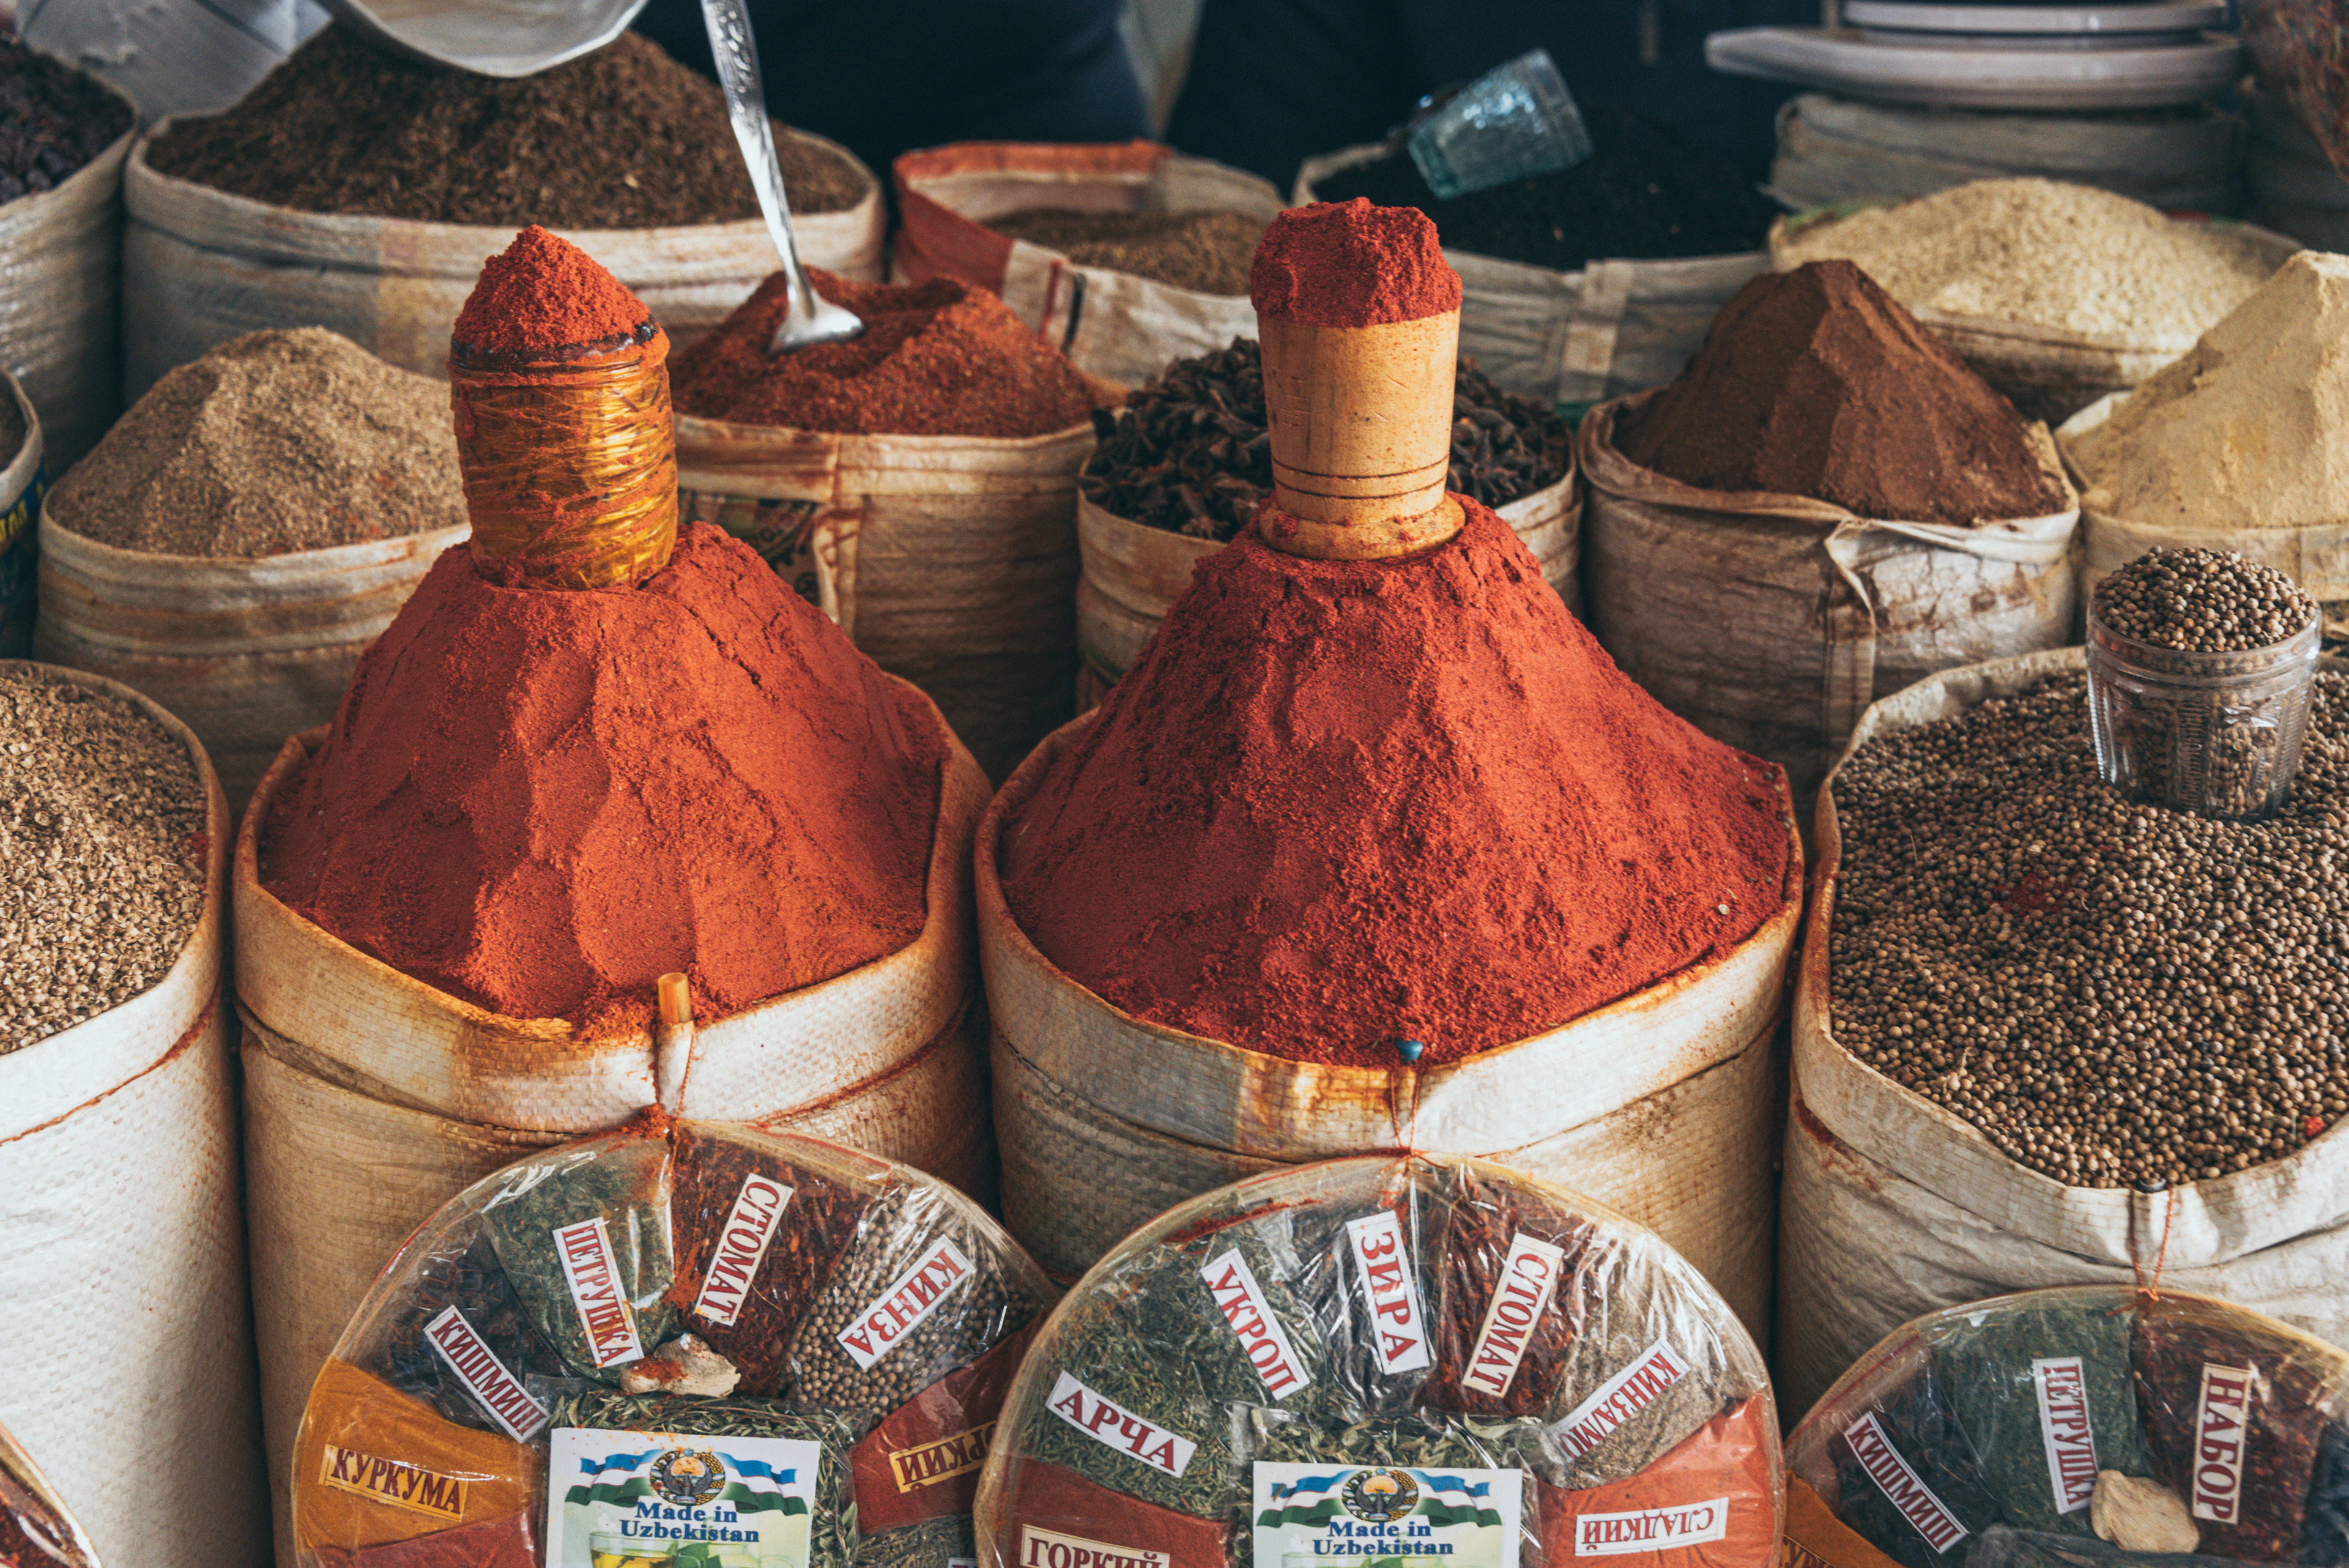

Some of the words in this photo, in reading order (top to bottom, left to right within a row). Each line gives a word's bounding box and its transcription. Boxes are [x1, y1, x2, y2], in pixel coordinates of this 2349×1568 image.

[562, 1224, 634, 1363] ПЕТРУШКА
[700, 1182, 780, 1321] С/ТОМАТ
[843, 1248, 965, 1356] КИНЗА
[1361, 1231, 1417, 1363] ЗИРА
[432, 1314, 547, 1435] КИШМИШ
[1208, 1264, 1298, 1391] УКРОП
[1471, 1253, 1549, 1393] С/ТОМАТ
[896, 1427, 997, 1490] РКИЙ
[1053, 1390, 1176, 1473] АРЧА
[1560, 1351, 1681, 1460] КИНЗА/МО
[2043, 1364, 2098, 1505] ПЕТРУШКА
[2197, 1372, 2246, 1520] НАБОР
[330, 1448, 461, 1514] КУРКУМА
[619, 1520, 759, 1542] Uzbekistan
[634, 1502, 705, 1521] Made
[714, 1506, 738, 1523] in
[1327, 1522, 1400, 1537] Made
[1408, 1521, 1431, 1537] in
[1581, 1507, 1714, 1550] СЛАДКИЙ
[1850, 1420, 1960, 1551] КИШМИШ
[1313, 1539, 1453, 1555] Uzbekistan
